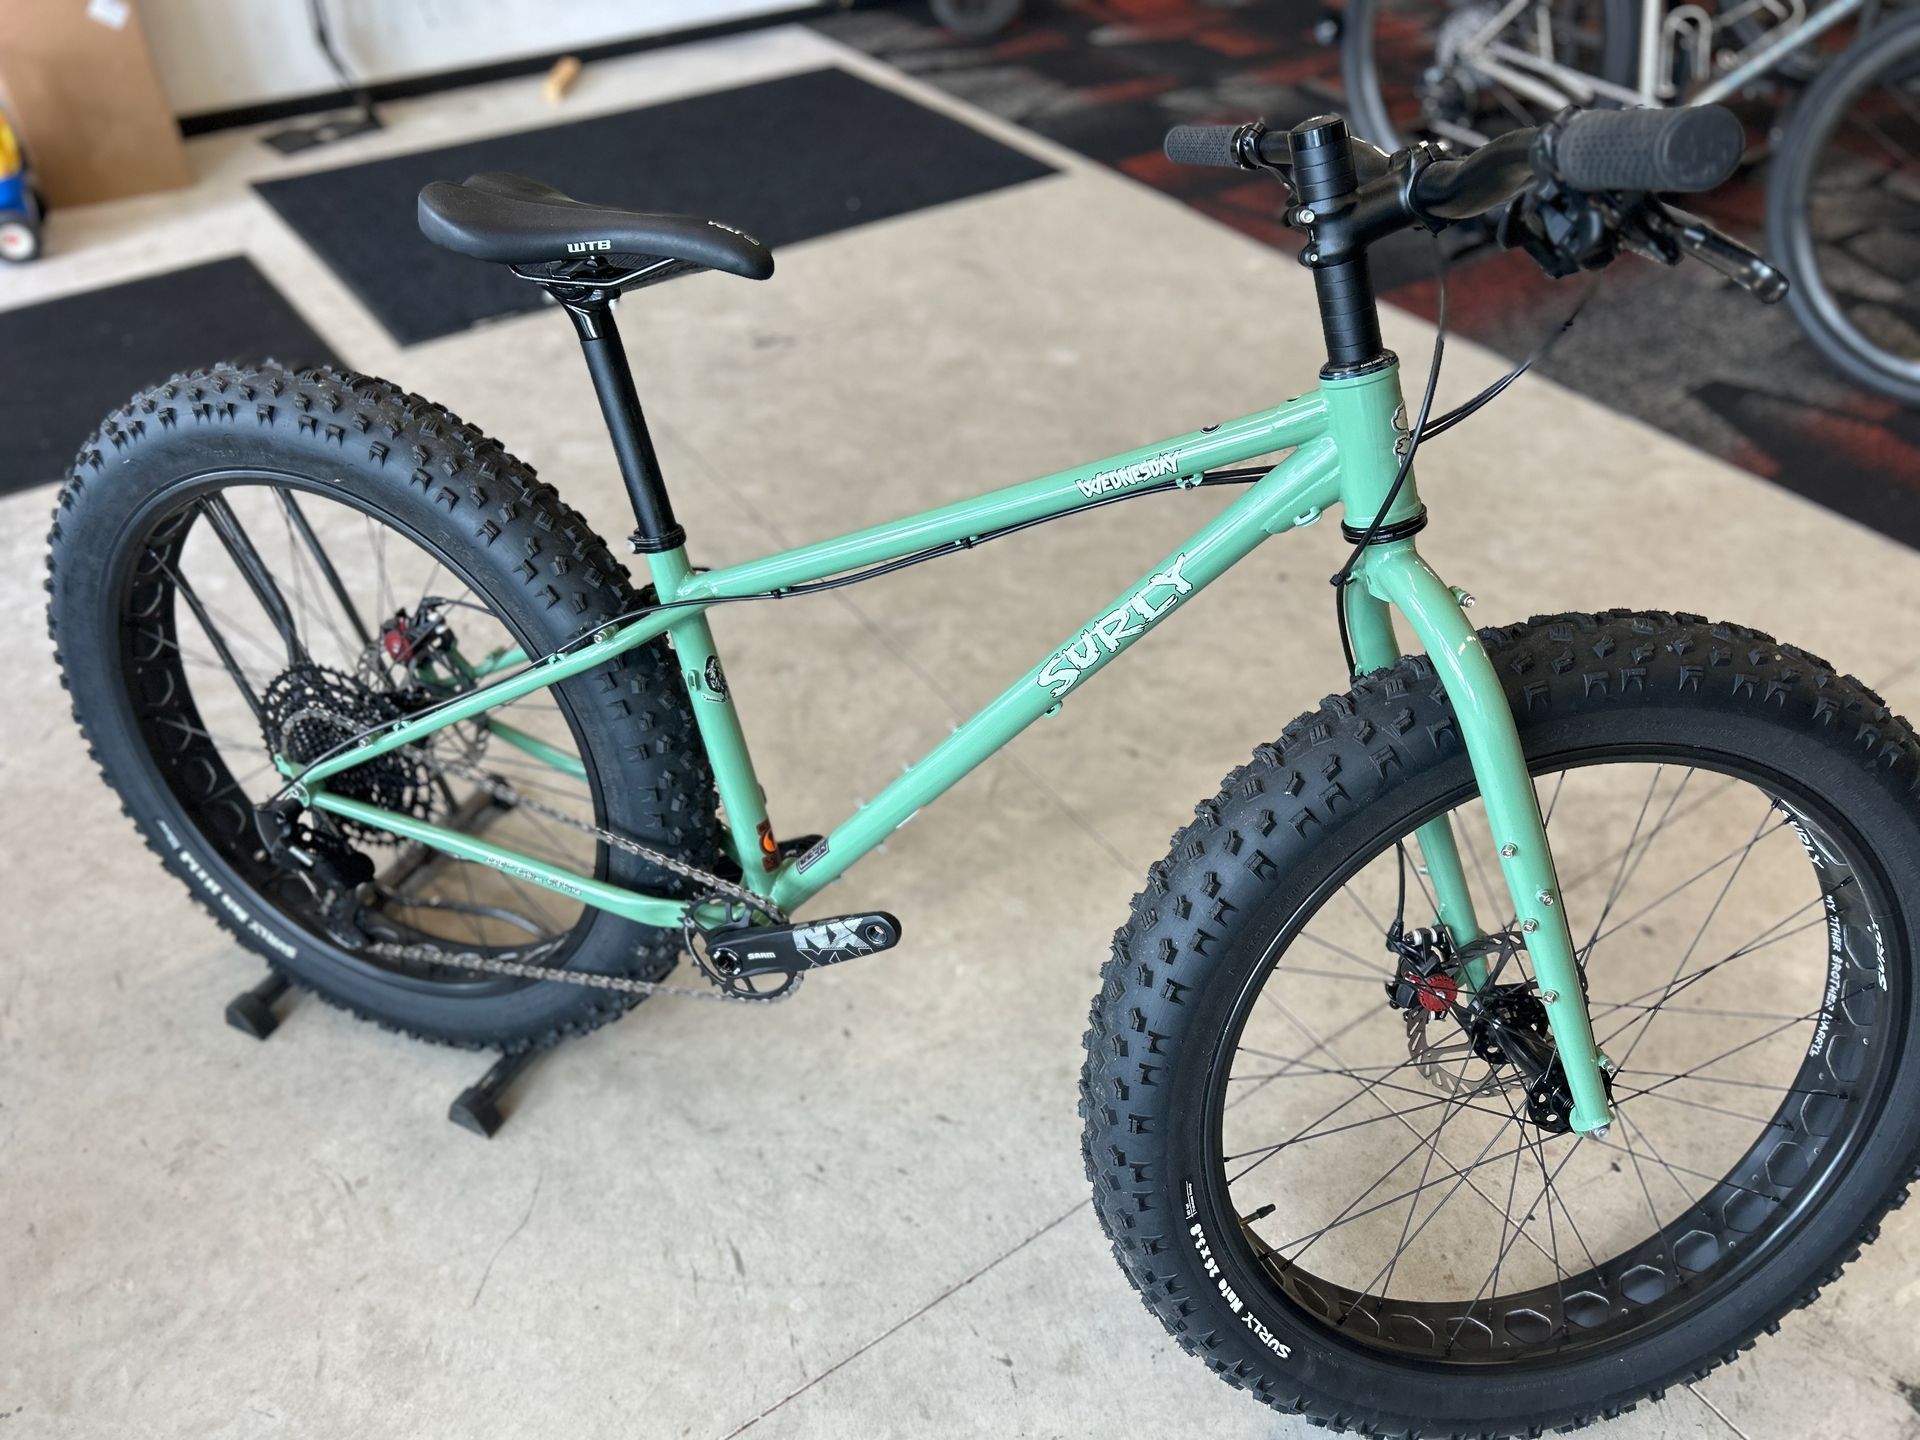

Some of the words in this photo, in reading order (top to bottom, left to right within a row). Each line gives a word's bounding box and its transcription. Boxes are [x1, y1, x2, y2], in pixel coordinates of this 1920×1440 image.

[567, 239, 611, 253] WTB
[1075, 449, 1182, 497] WEDNESDAY
[1037, 552, 1193, 698] SURLY
[1826, 894, 1836, 911] MY
[792, 917, 870, 950] NX
[1218, 1278, 1244, 1313] Nate
[1242, 1311, 1292, 1359] SURLY
